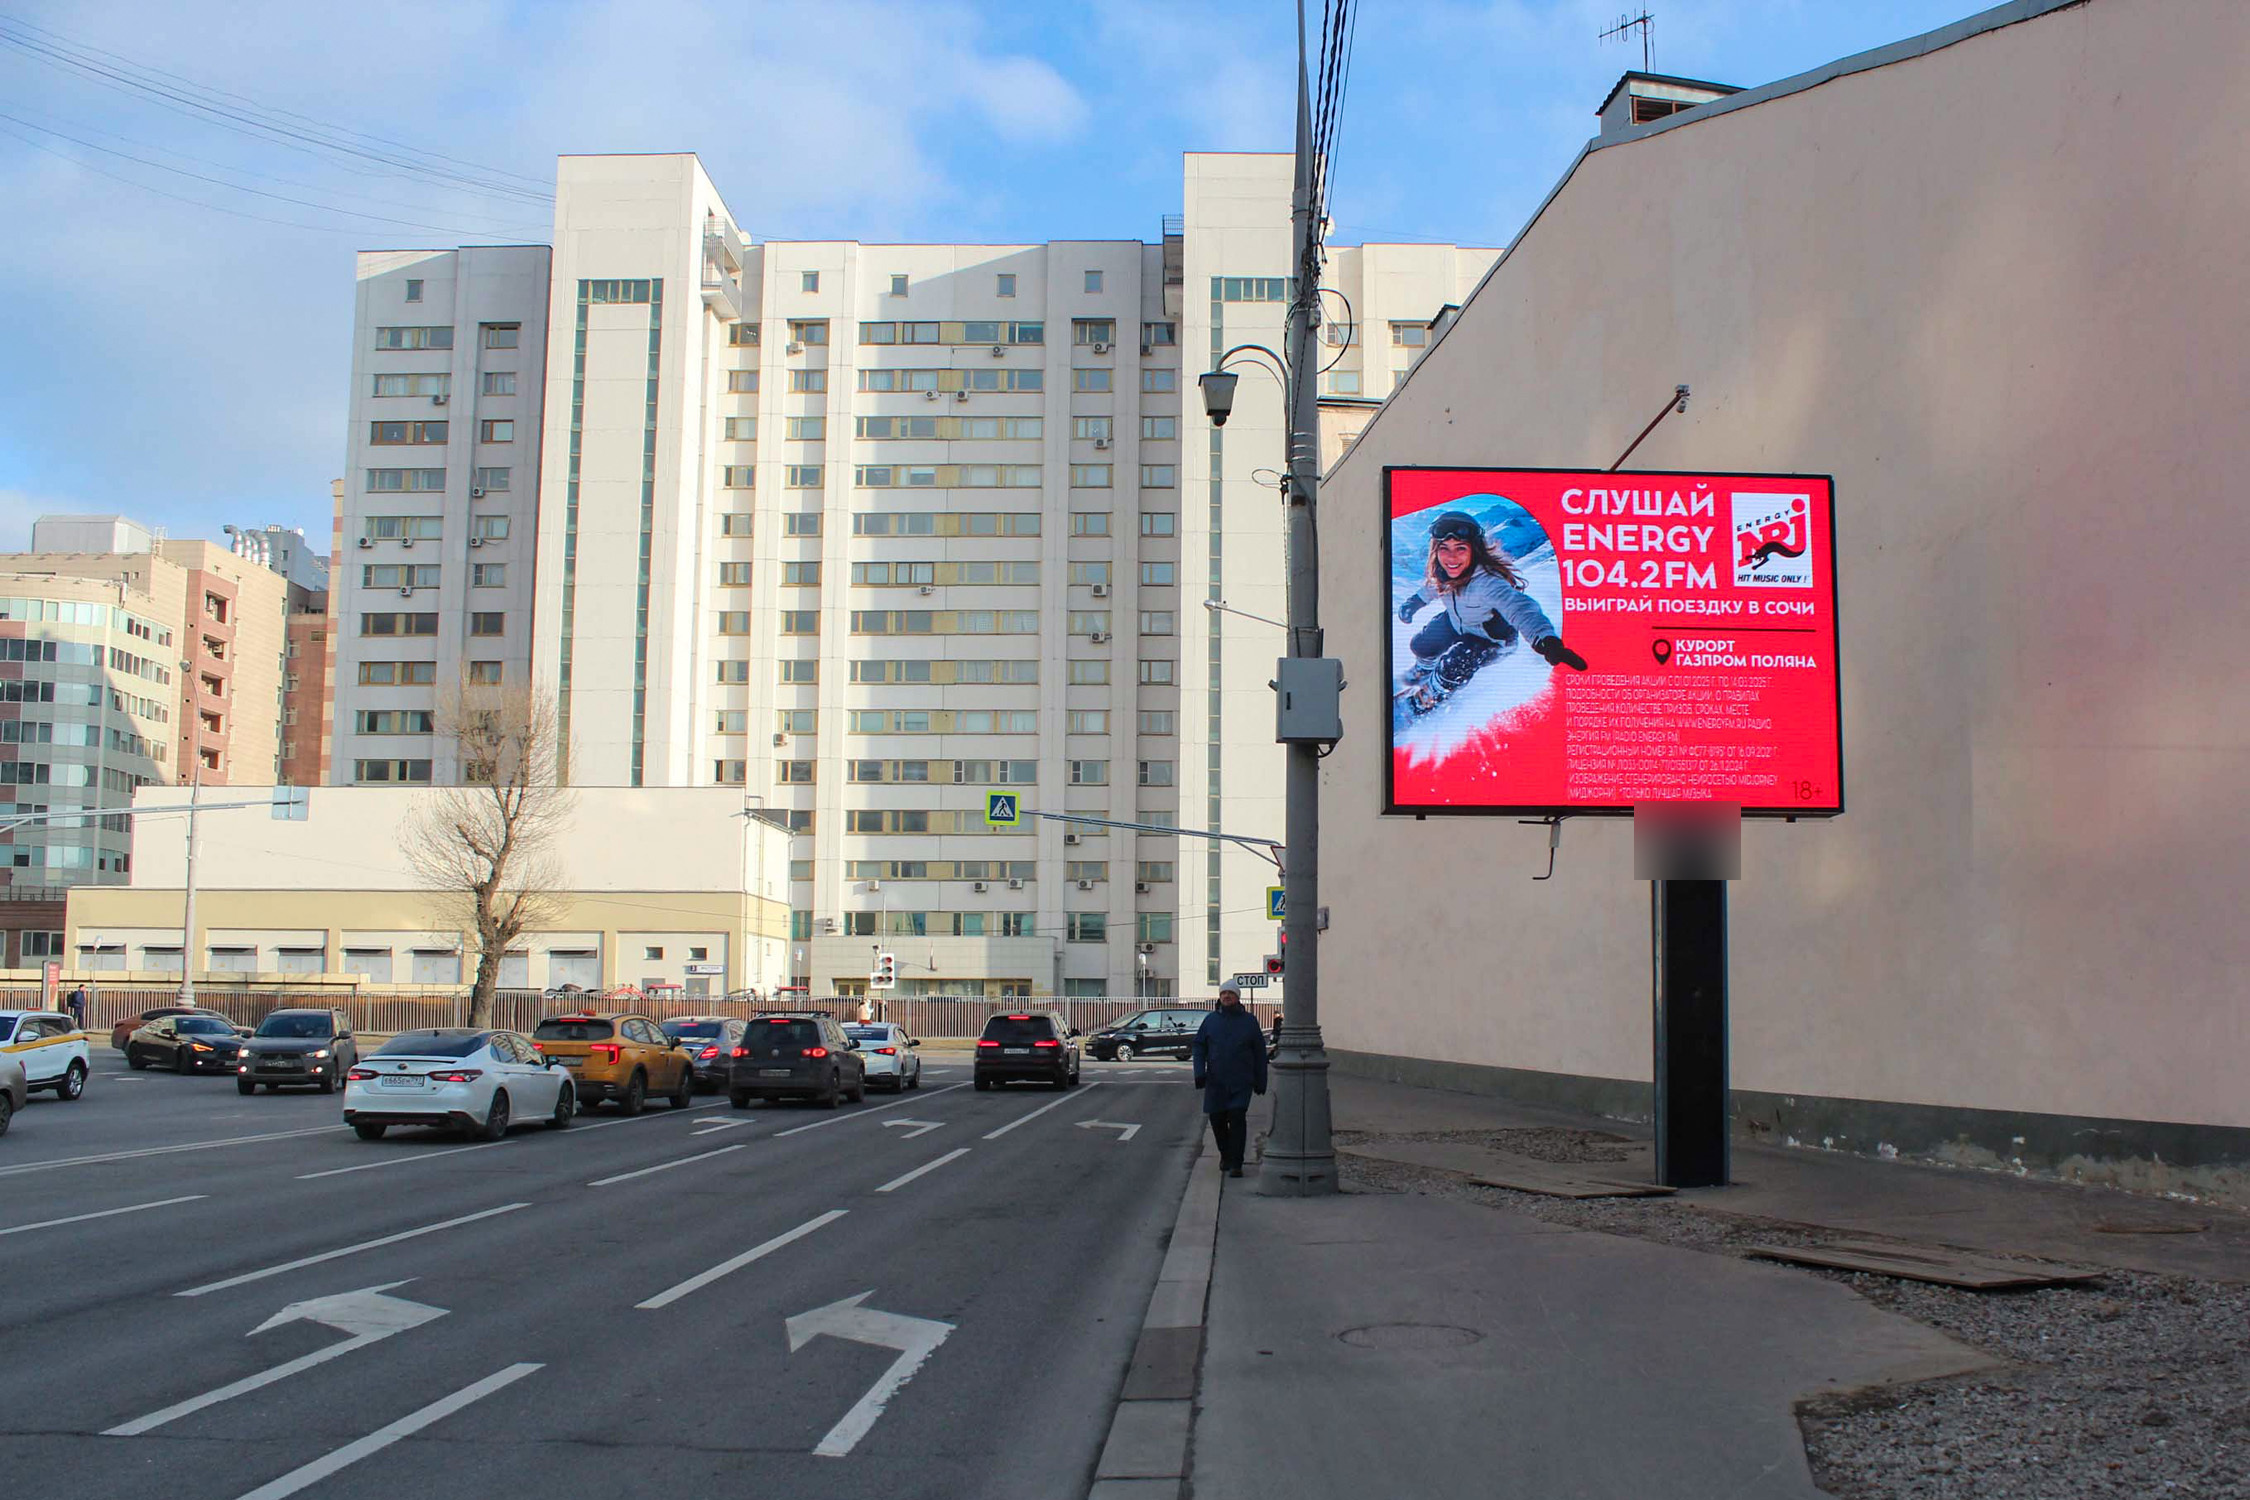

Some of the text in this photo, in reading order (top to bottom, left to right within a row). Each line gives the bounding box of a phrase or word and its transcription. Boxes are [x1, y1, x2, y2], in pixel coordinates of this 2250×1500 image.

[1561, 482, 1715, 517] СЛУШАЙ
[1737, 509, 1790, 532] ENERGY
[1563, 523, 1715, 553] ENERGY
[1737, 574, 1751, 583] HIT
[1752, 574, 1780, 583] MUSIC
[1781, 575, 1802, 584] ONLY
[1564, 594, 1815, 615] ВЫИГРАЙ ПОЕЗДКУ В СОЧИ
[1676, 639, 1736, 652] КУРОРТ
[1676, 653, 1817, 669] ГАЗПРОМ ПОЛЯНА
[1791, 780, 1822, 800] 18+
[1236, 975, 1264, 986] СТОП
